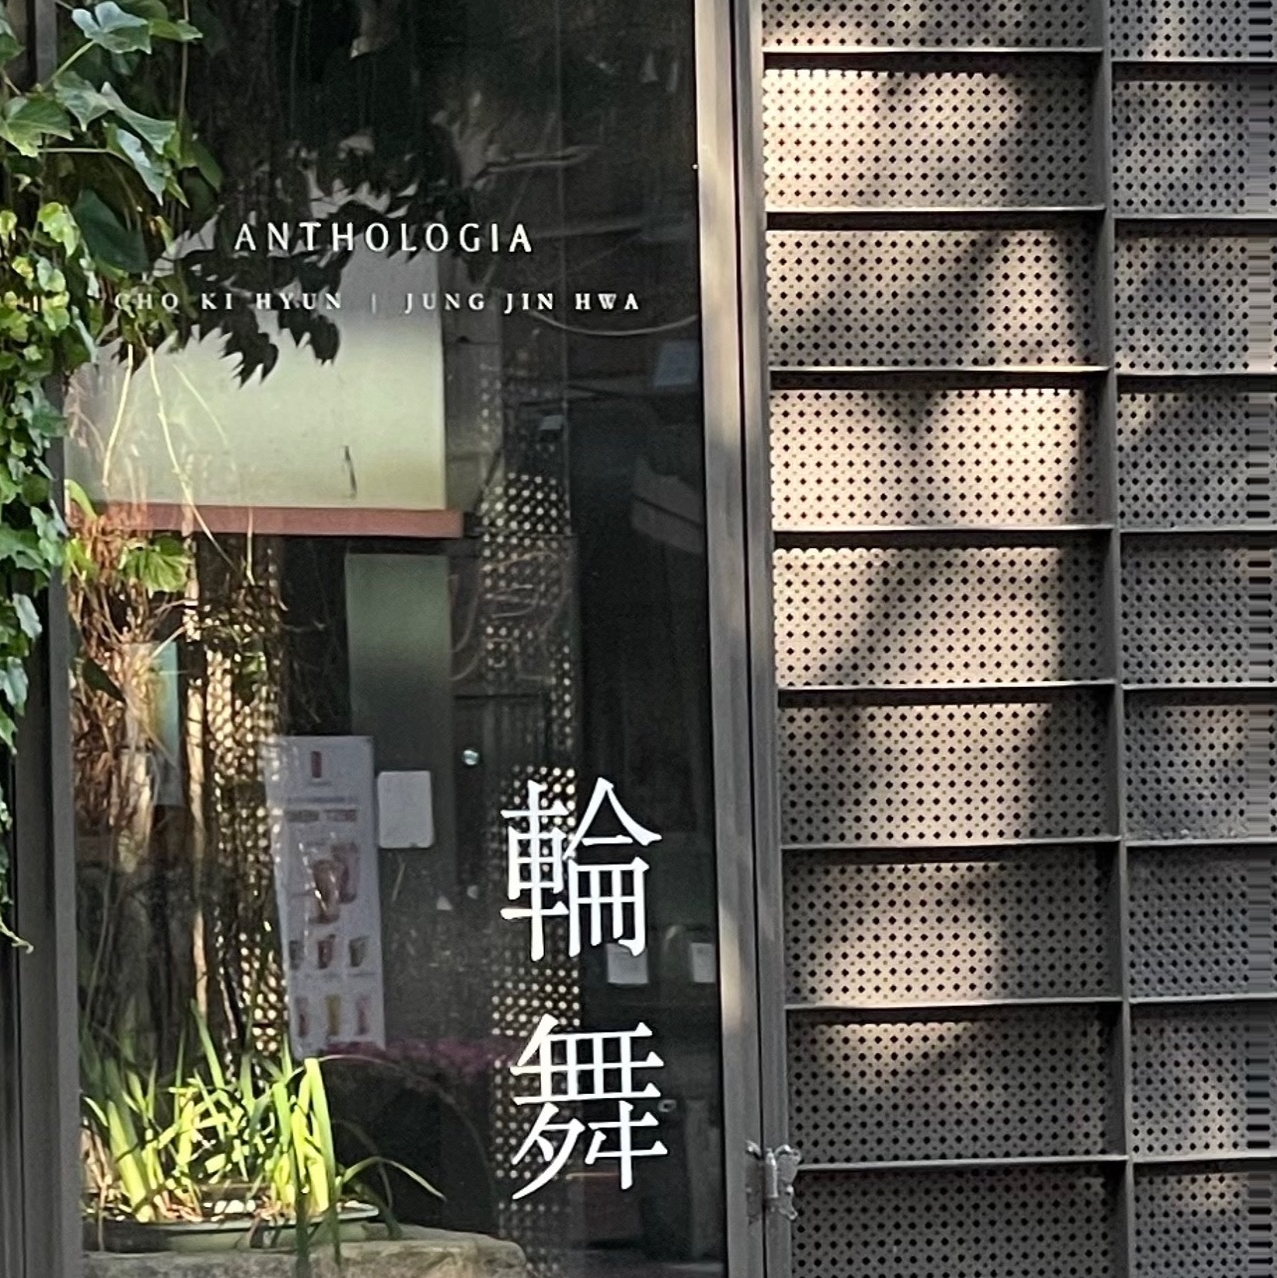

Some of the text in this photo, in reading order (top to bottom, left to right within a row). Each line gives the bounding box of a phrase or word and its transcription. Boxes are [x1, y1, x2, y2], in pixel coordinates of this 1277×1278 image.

[234, 221, 533, 252] ANTHOLOGIA
[201, 292, 234, 311] KI
[255, 292, 342, 311] HYUN
[405, 293, 485, 315] JUNG
[504, 293, 554, 315] JIN
[574, 293, 639, 310] HWA
[500, 776, 669, 1201] 輪舞
